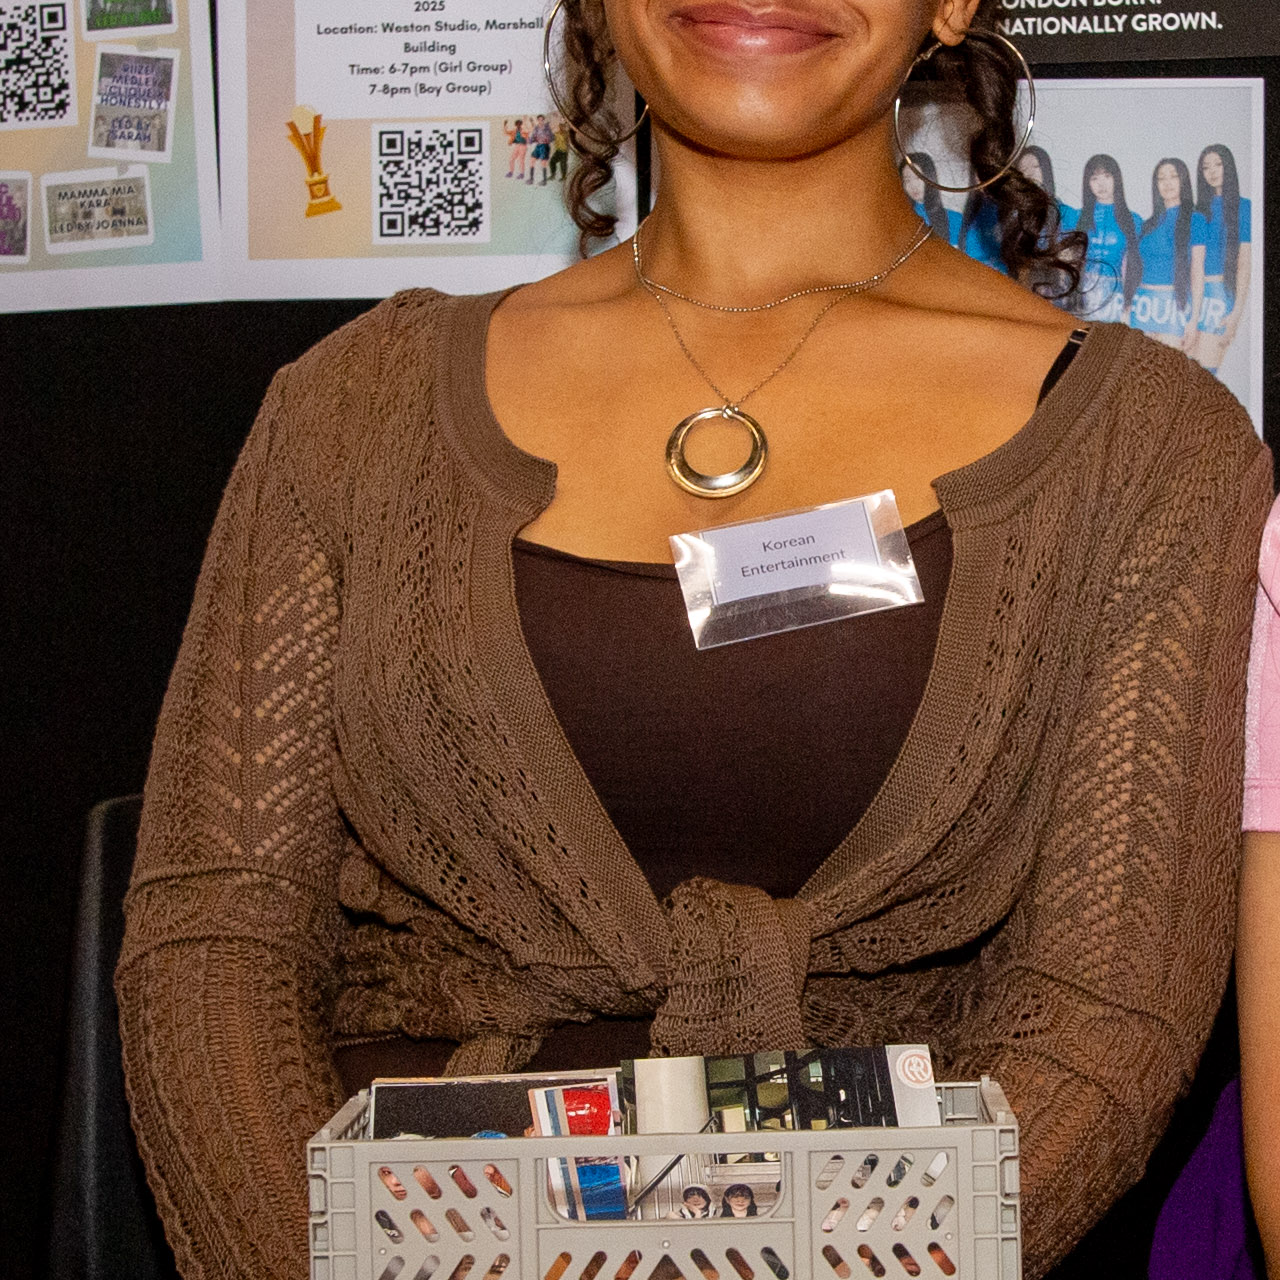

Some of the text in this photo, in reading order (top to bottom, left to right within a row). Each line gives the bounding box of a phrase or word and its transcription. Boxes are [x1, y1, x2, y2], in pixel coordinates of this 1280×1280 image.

[414, 0, 446, 12] 2025
[317, 18, 544, 35] Location: Weston Studio, Marshall
[1131, 12, 1223, 32] GROWN.
[404, 42, 457, 55] Building
[349, 60, 513, 76] Time: 6-7pm (Girl Group)
[369, 81, 492, 97] 7-8pm (Boy Group)
[58, 185, 136, 201] MAMMA MIA
[80, 199, 111, 209] KARA
[95, 217, 146, 231] JOANNA
[762, 532, 816, 553] Korean
[741, 548, 847, 578] Entertainment
